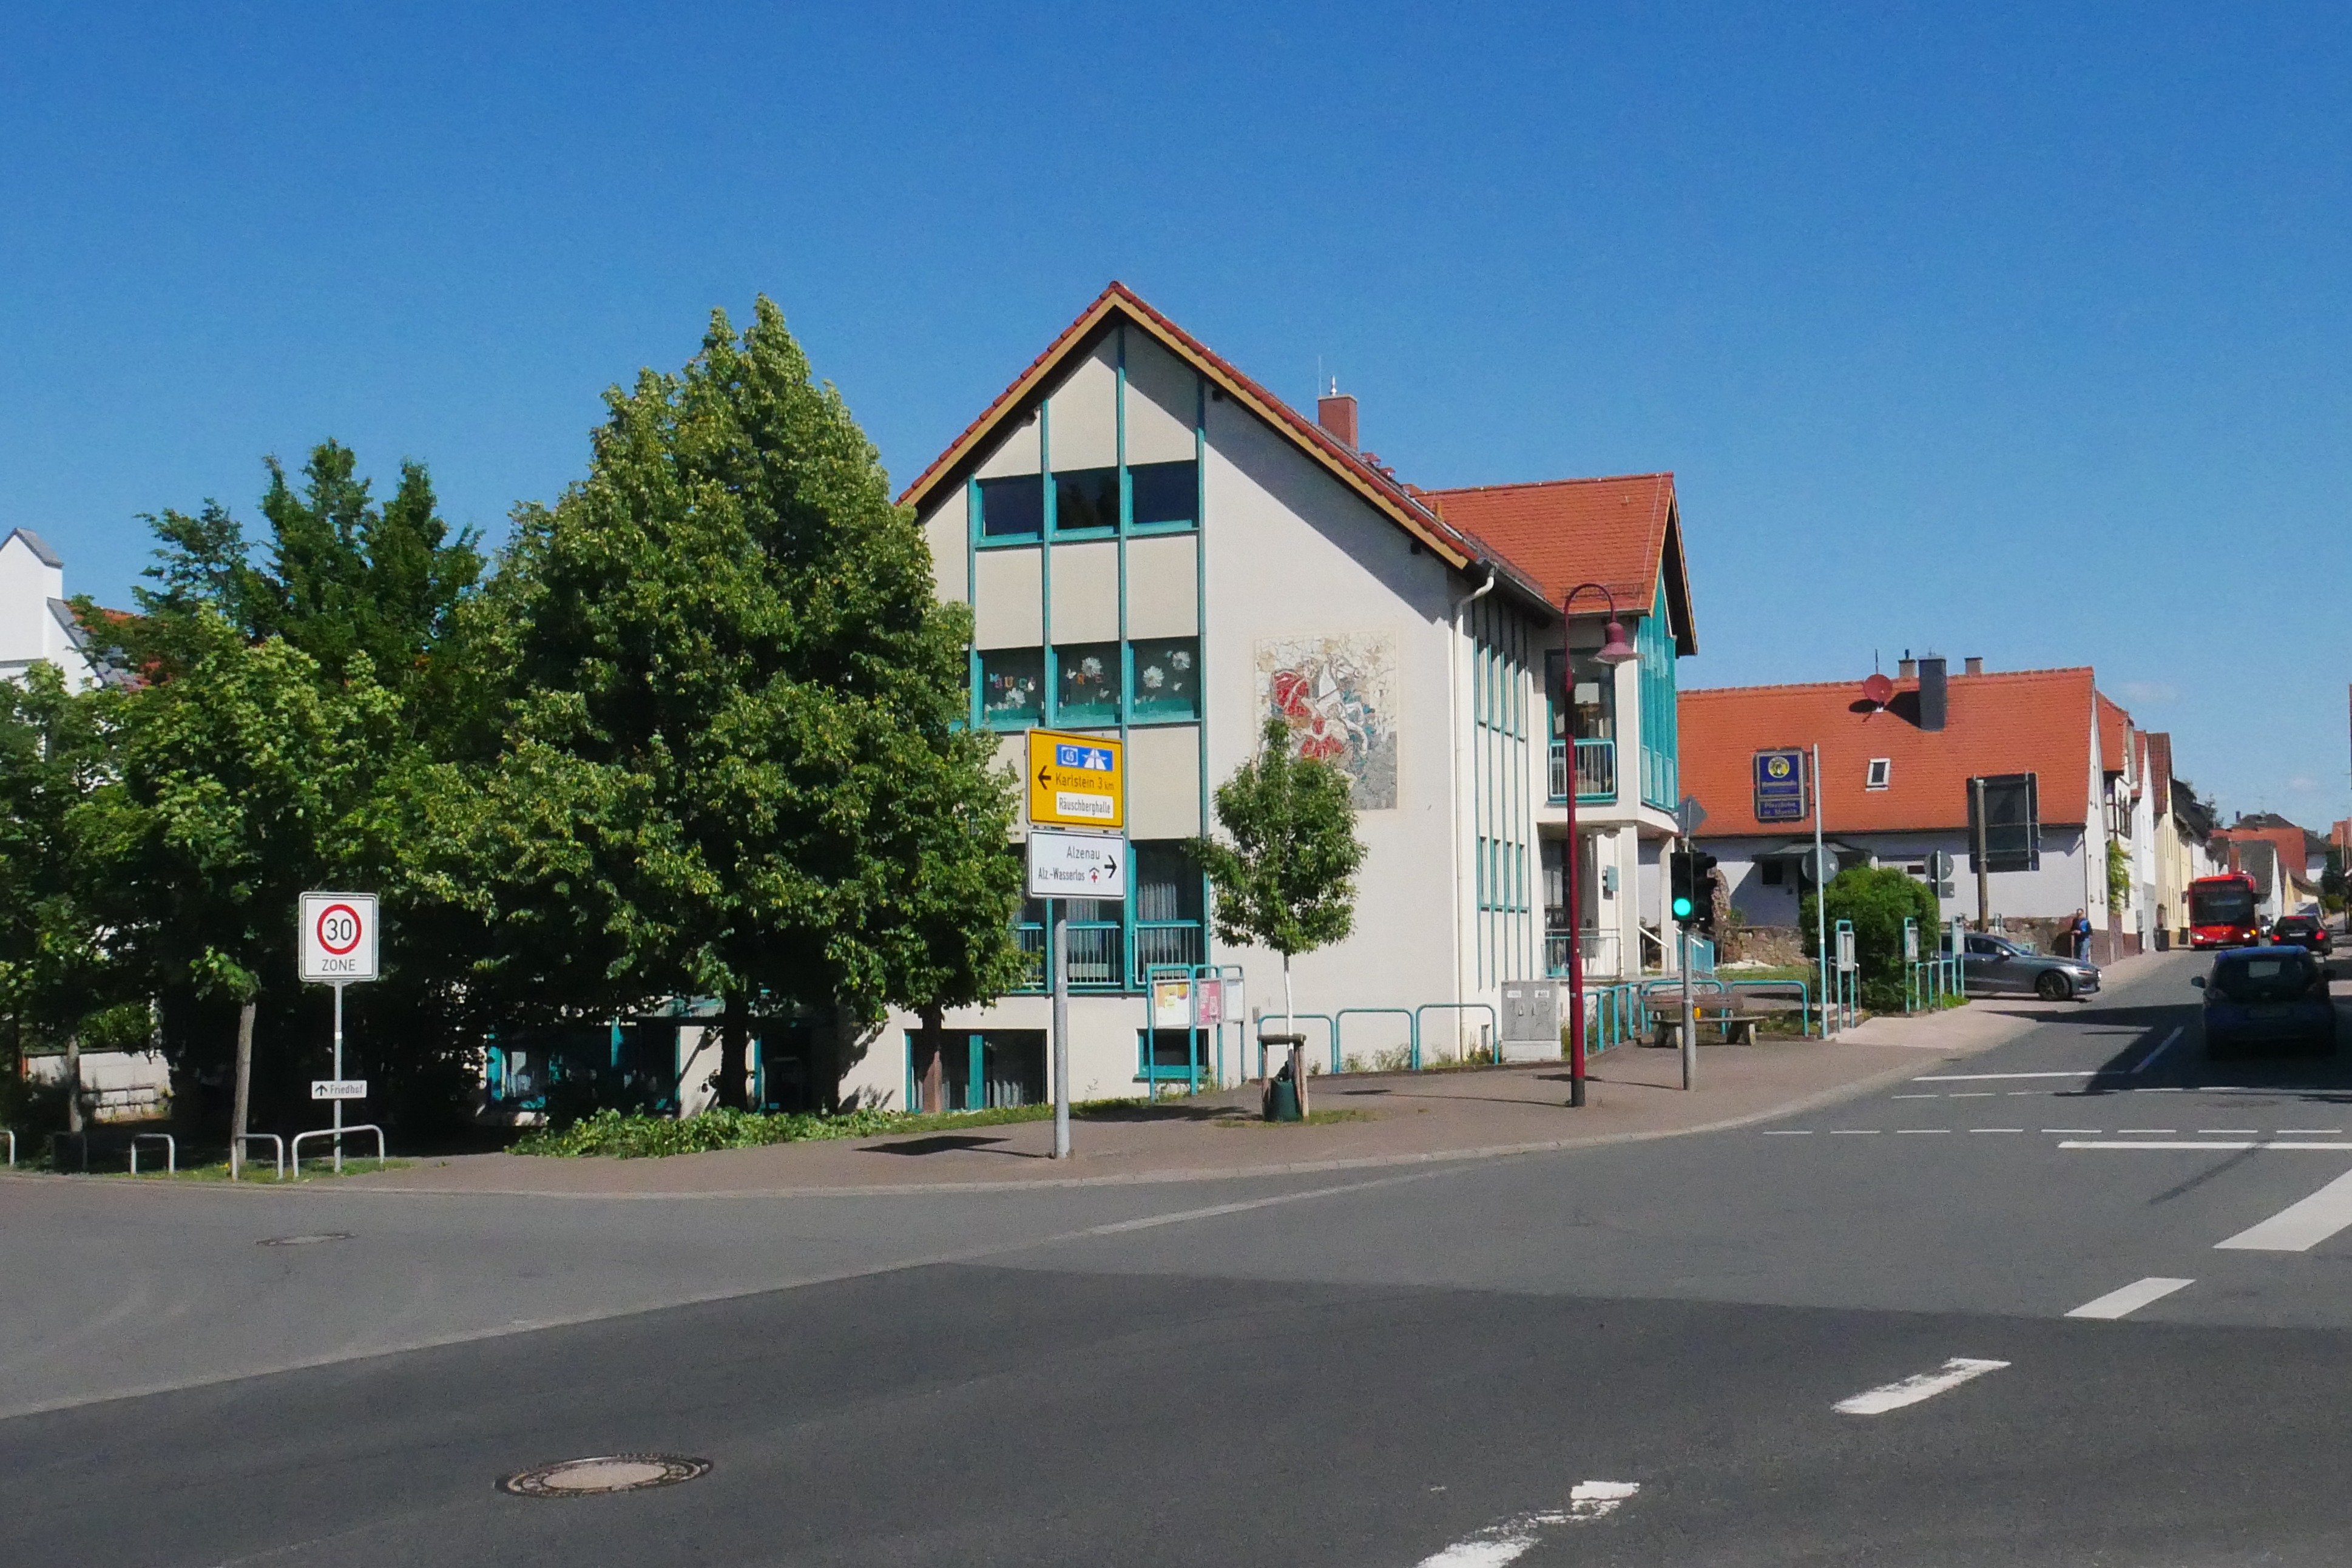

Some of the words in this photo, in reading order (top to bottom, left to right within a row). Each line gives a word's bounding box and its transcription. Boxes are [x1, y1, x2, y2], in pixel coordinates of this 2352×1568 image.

[1055, 772, 1095, 789] Karlstein
[1098, 777, 1103, 789] 3
[1104, 782, 1114, 790] km
[1059, 797, 1110, 815] Räuschberghalle
[1066, 846, 1100, 860] Alzenau
[1038, 867, 1085, 881] Alz.-Wasserlos
[326, 918, 353, 941] 30
[322, 959, 356, 972] ZONE
[330, 1084, 363, 1094] Friedhof
